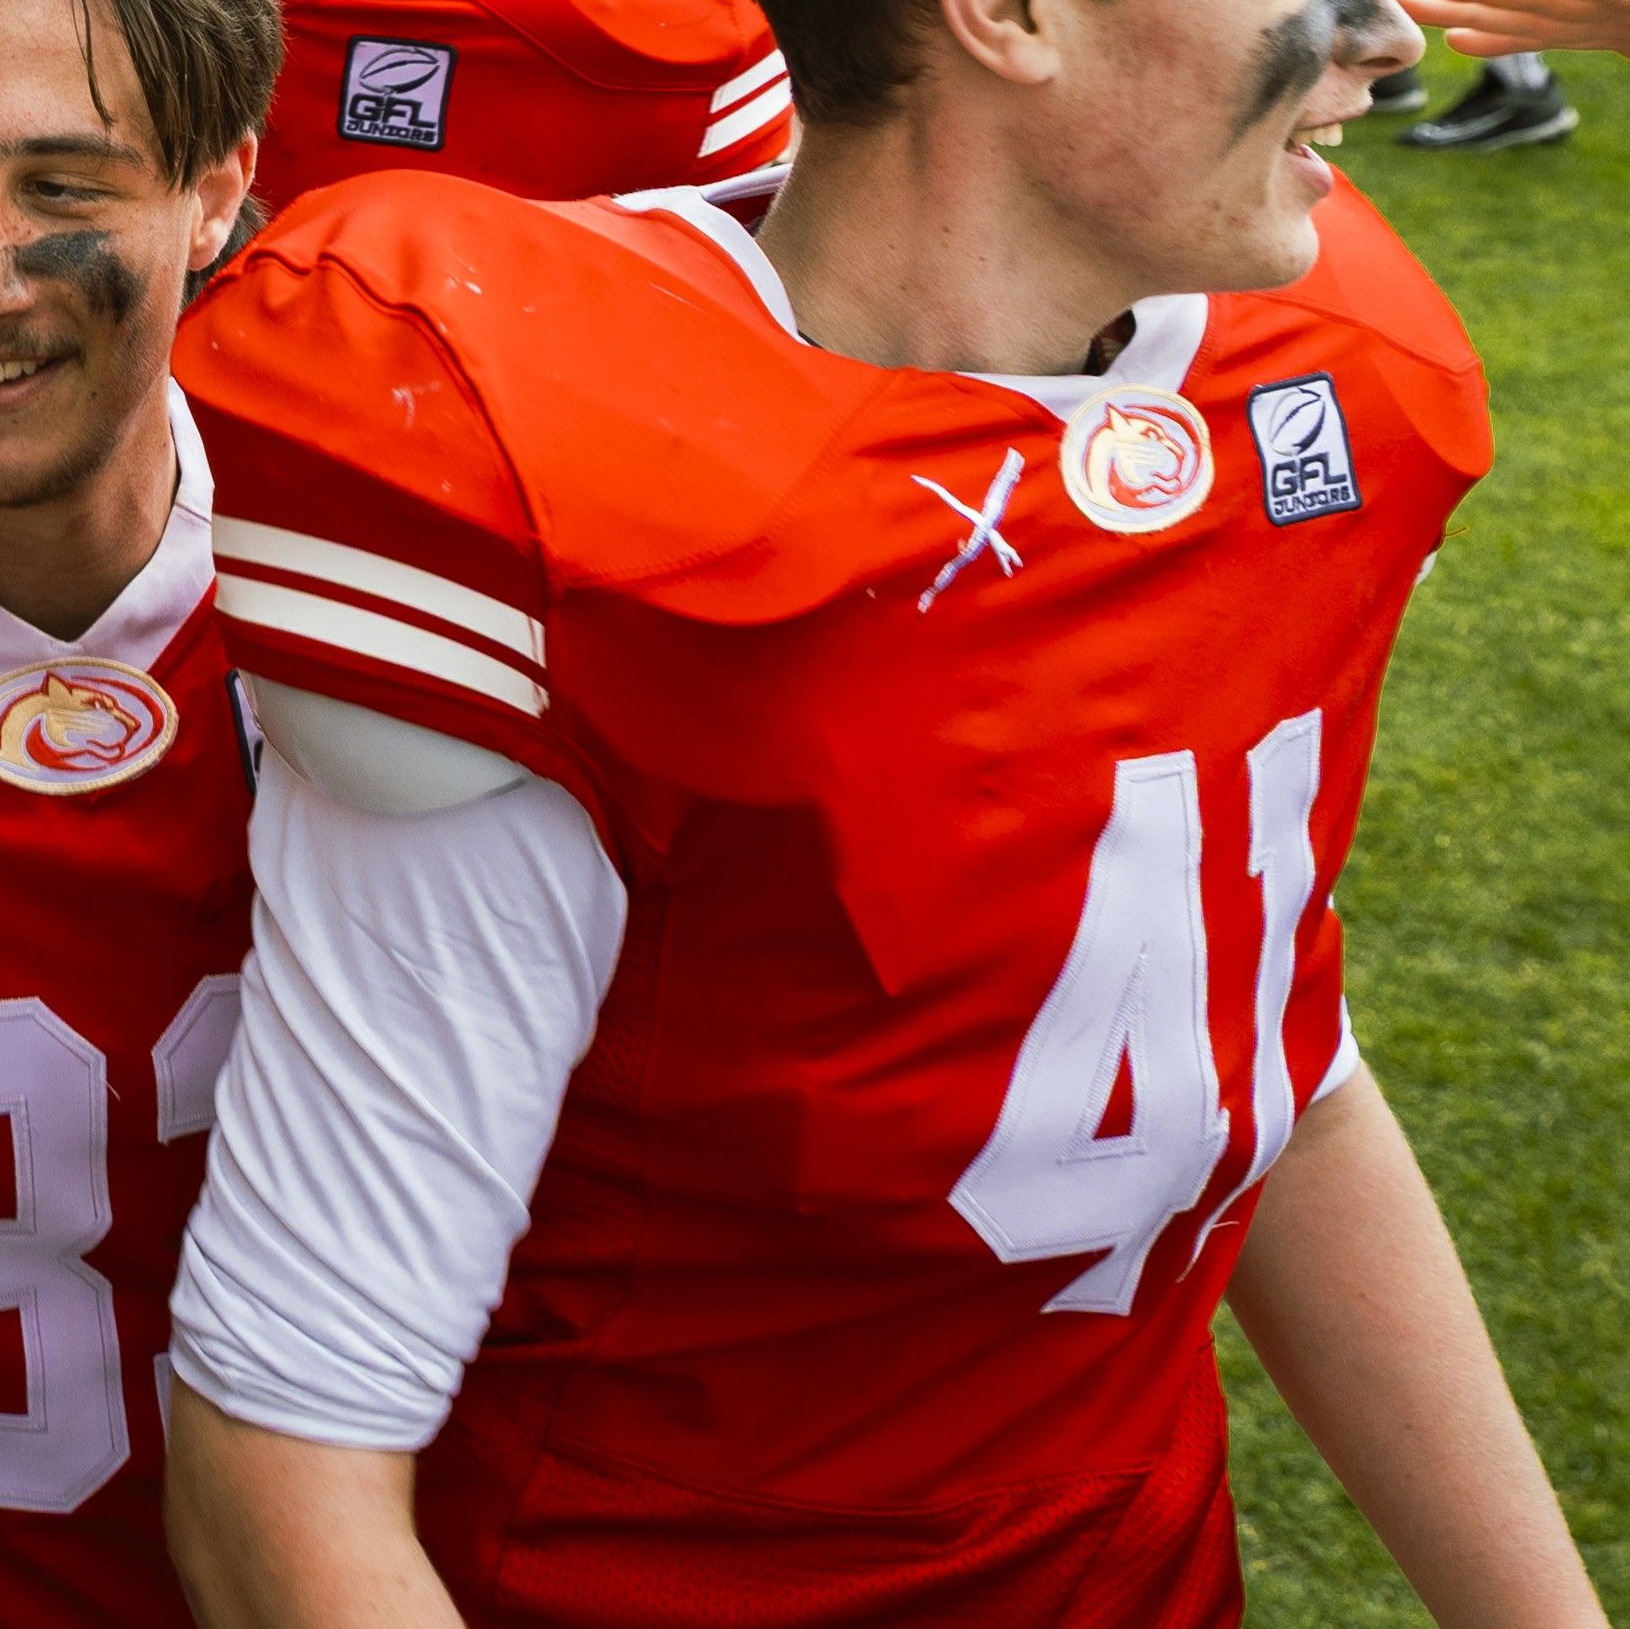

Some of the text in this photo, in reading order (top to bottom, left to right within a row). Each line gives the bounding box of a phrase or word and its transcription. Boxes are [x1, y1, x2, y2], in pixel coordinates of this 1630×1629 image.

[348, 93, 438, 129] GFL
[346, 119, 437, 143] JUNIORS
[1272, 452, 1347, 499] GFL
[1274, 486, 1351, 516] JUNIORS
[946, 706, 1322, 1317] 41
